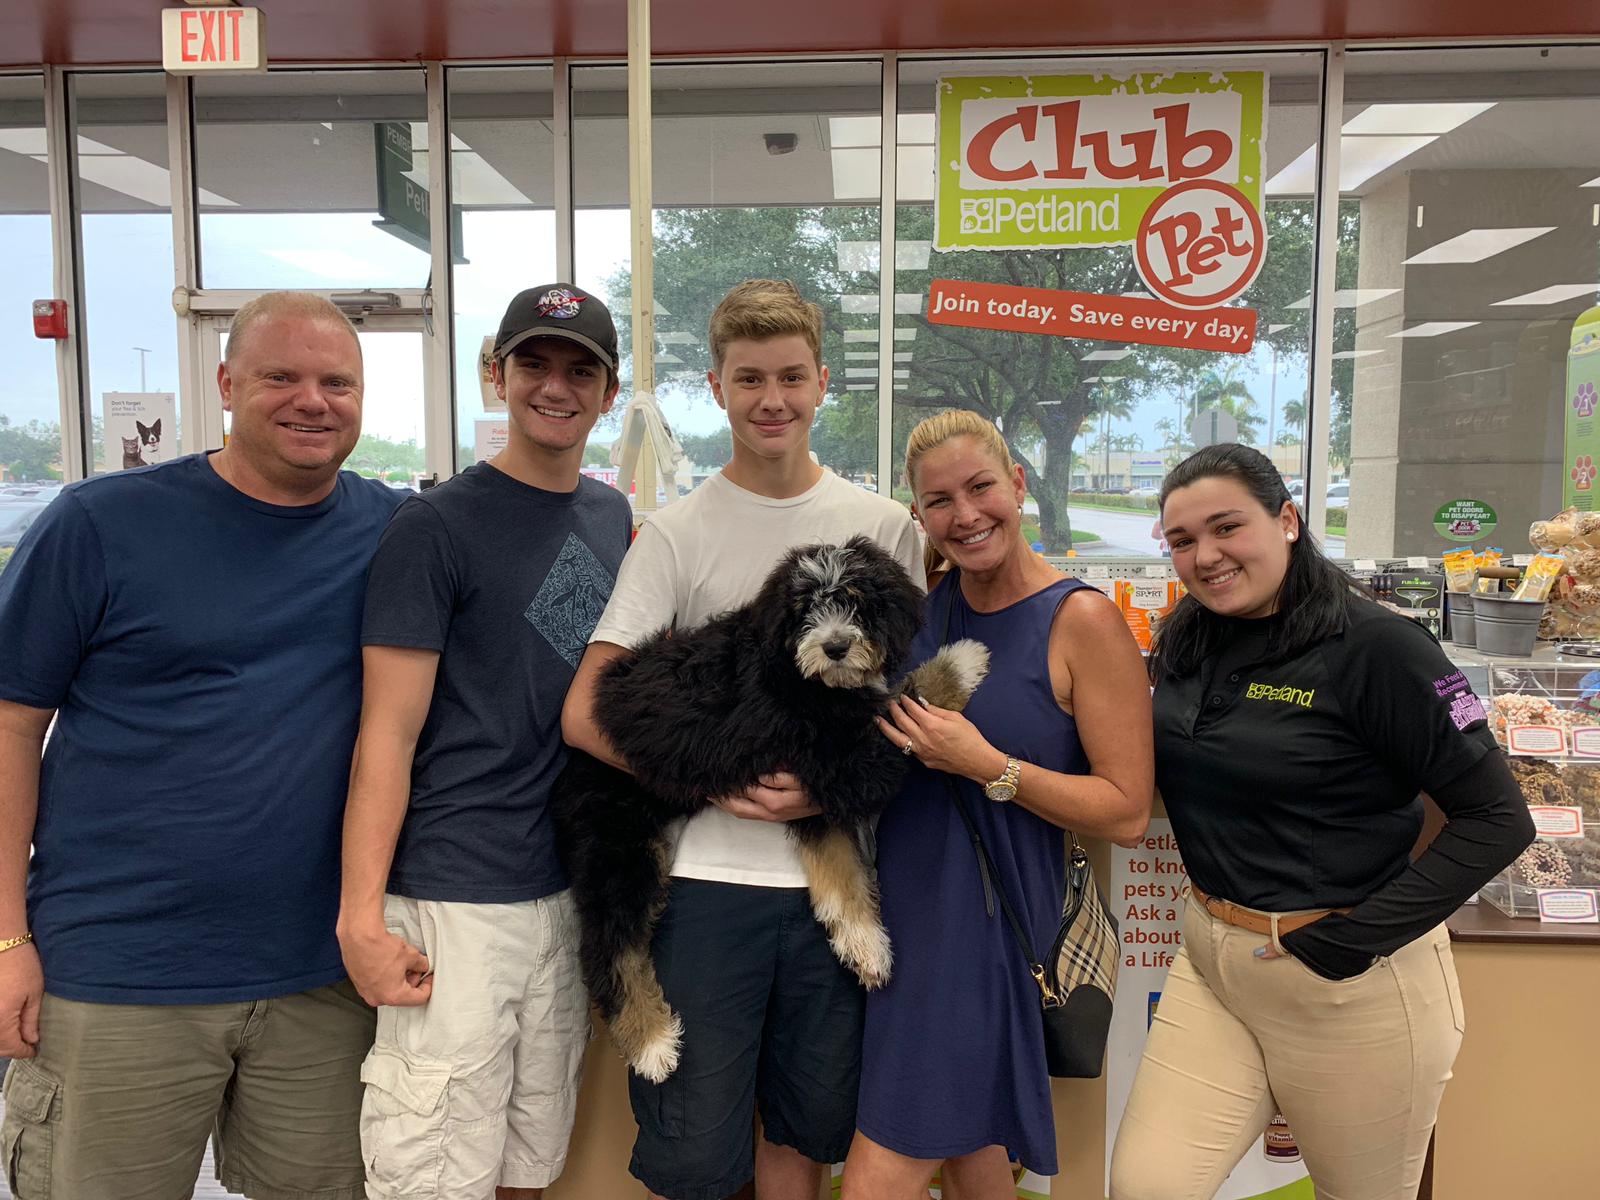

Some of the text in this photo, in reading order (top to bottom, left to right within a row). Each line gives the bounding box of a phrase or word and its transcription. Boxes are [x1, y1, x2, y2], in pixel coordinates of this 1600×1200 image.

[181, 10, 244, 62] EXIT
[966, 99, 1233, 183] Club
[994, 193, 1120, 234] Petland
[1148, 207, 1254, 288] Pet
[932, 291, 1250, 345] Join today. Save every day.
[1262, 684, 1316, 708] Petland
[1128, 858, 1149, 873] to
[1124, 882, 1166, 901] pets
[1126, 904, 1176, 921] Ask a
[1123, 927, 1182, 945] about
[1125, 954, 1136, 967] a
